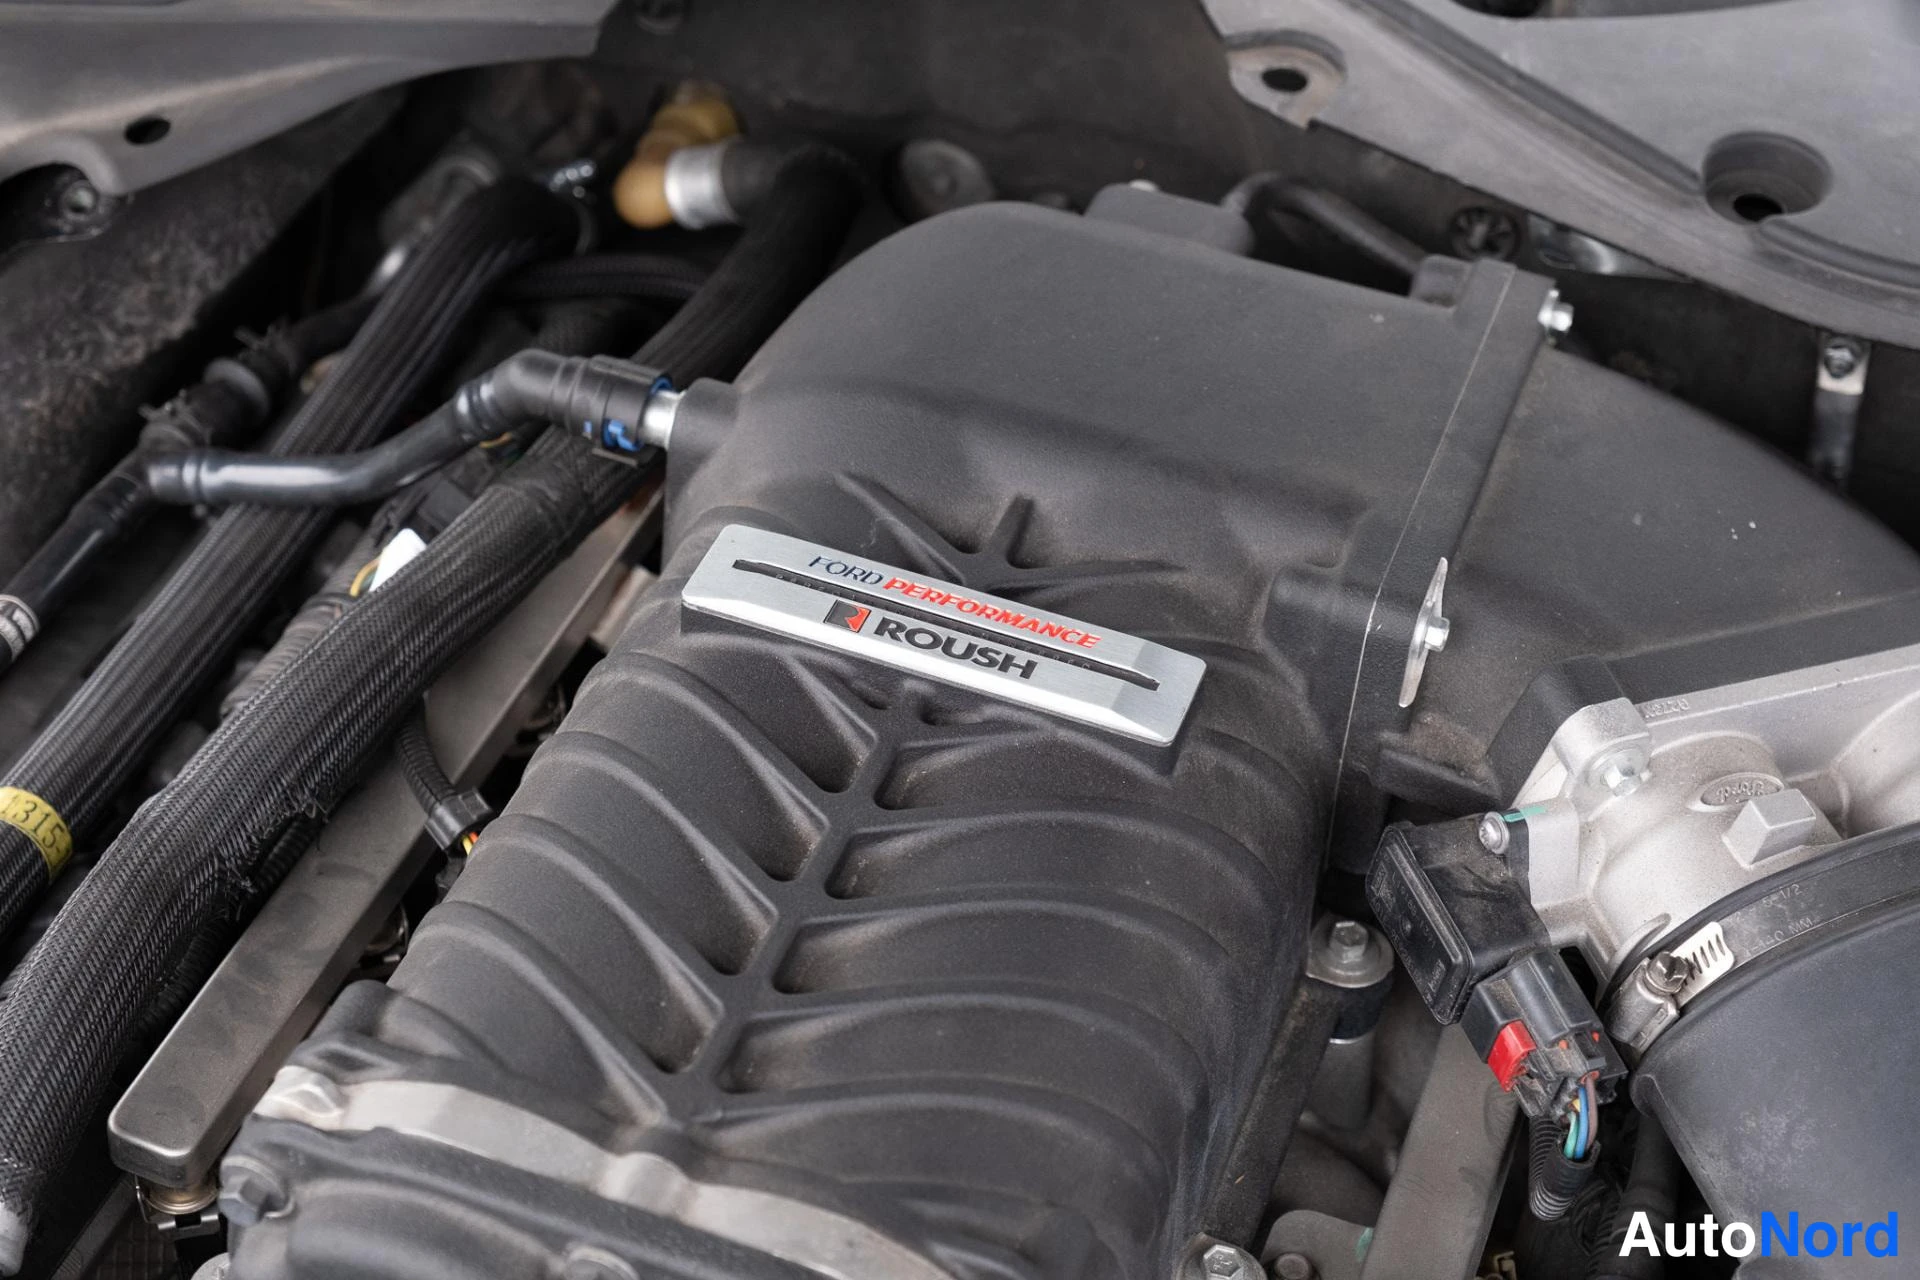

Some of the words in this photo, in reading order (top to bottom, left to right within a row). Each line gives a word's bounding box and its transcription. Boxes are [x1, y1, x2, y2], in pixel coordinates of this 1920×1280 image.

[808, 555, 884, 586] FORD
[882, 576, 1102, 649] PERFORMANCE
[873, 616, 1038, 680] ROUSH
